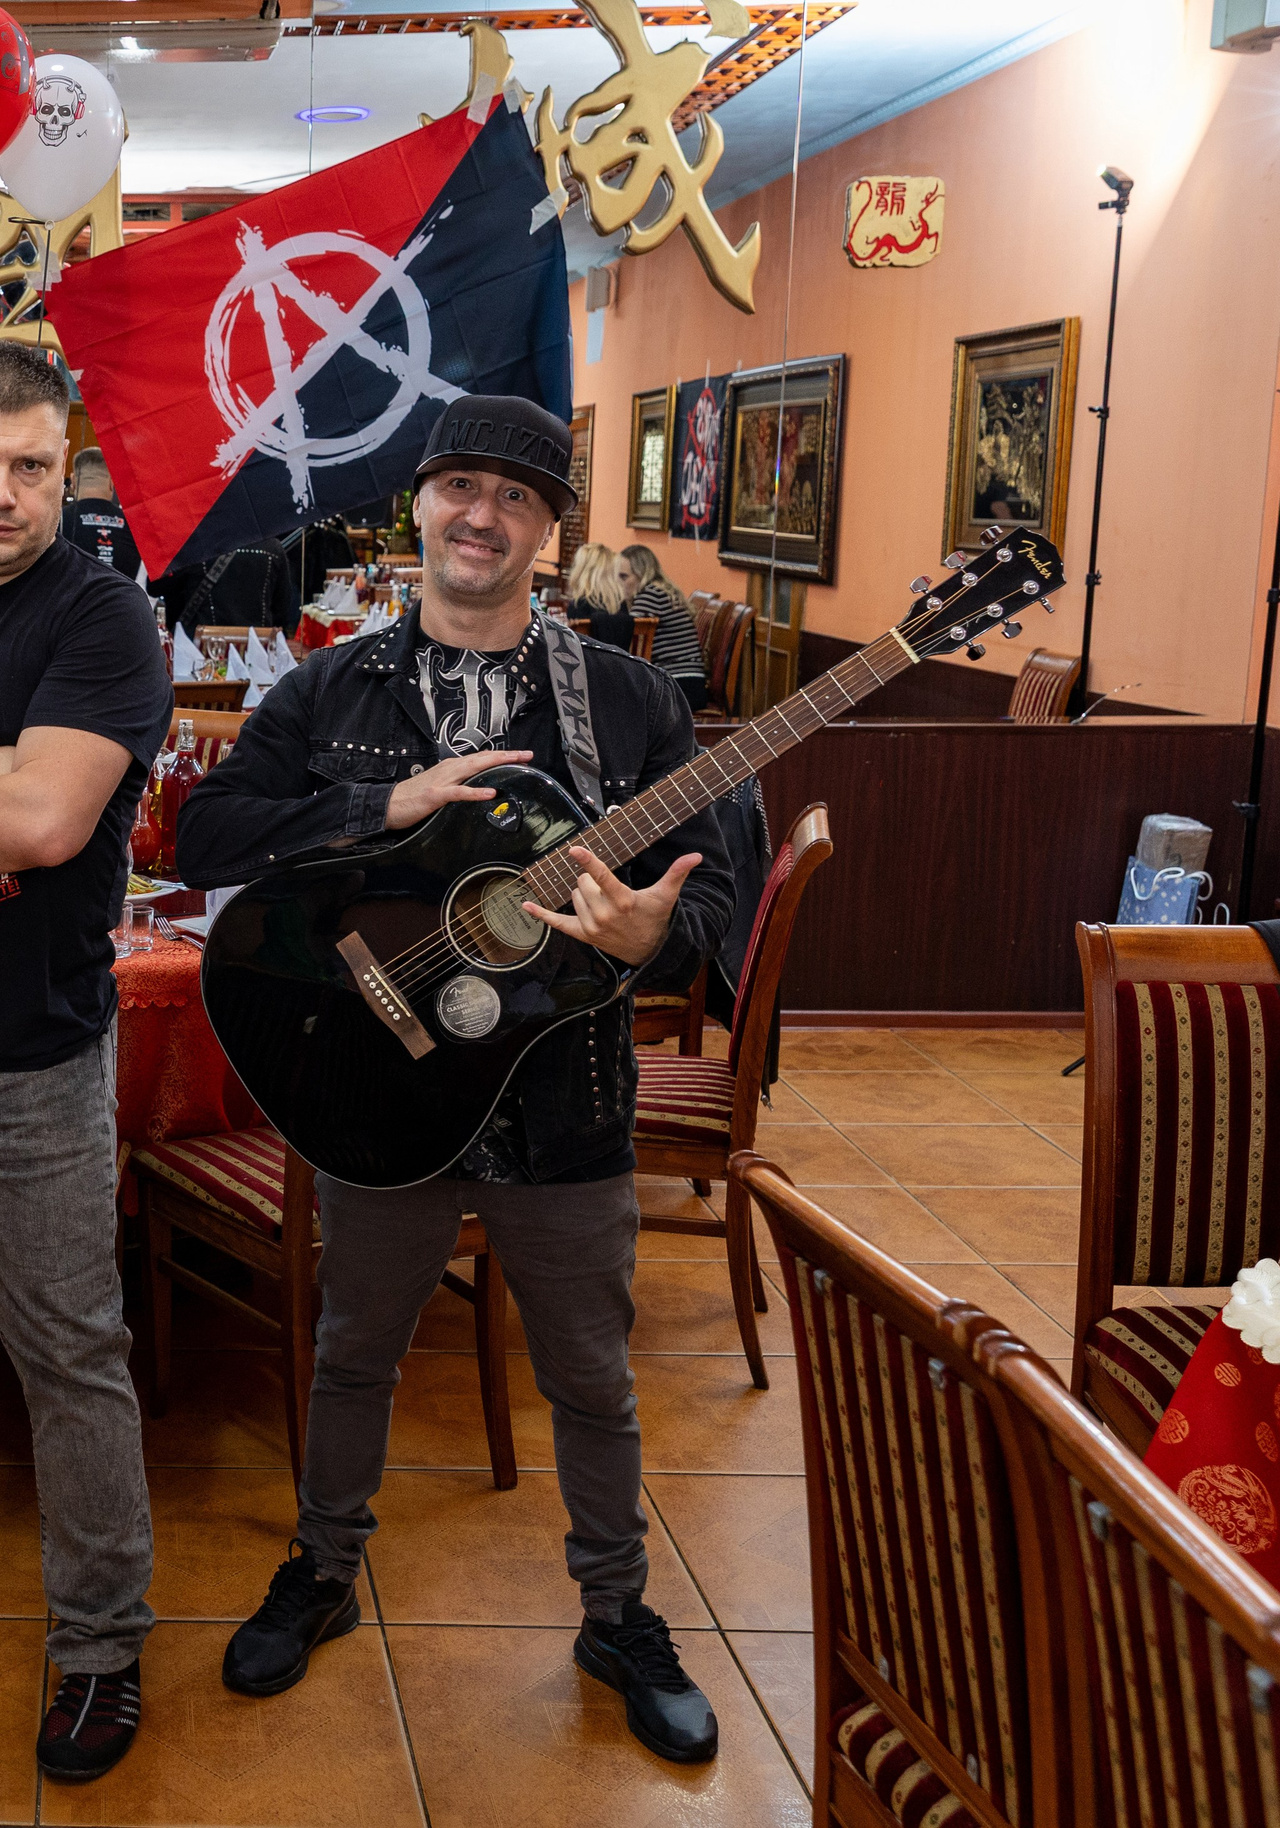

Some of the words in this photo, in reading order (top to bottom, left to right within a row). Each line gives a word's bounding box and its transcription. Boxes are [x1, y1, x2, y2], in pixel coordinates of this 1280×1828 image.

[444, 418, 495, 452] MC
[497, 423, 568, 475] IZOT
[1017, 539, 1053, 580] Fender
